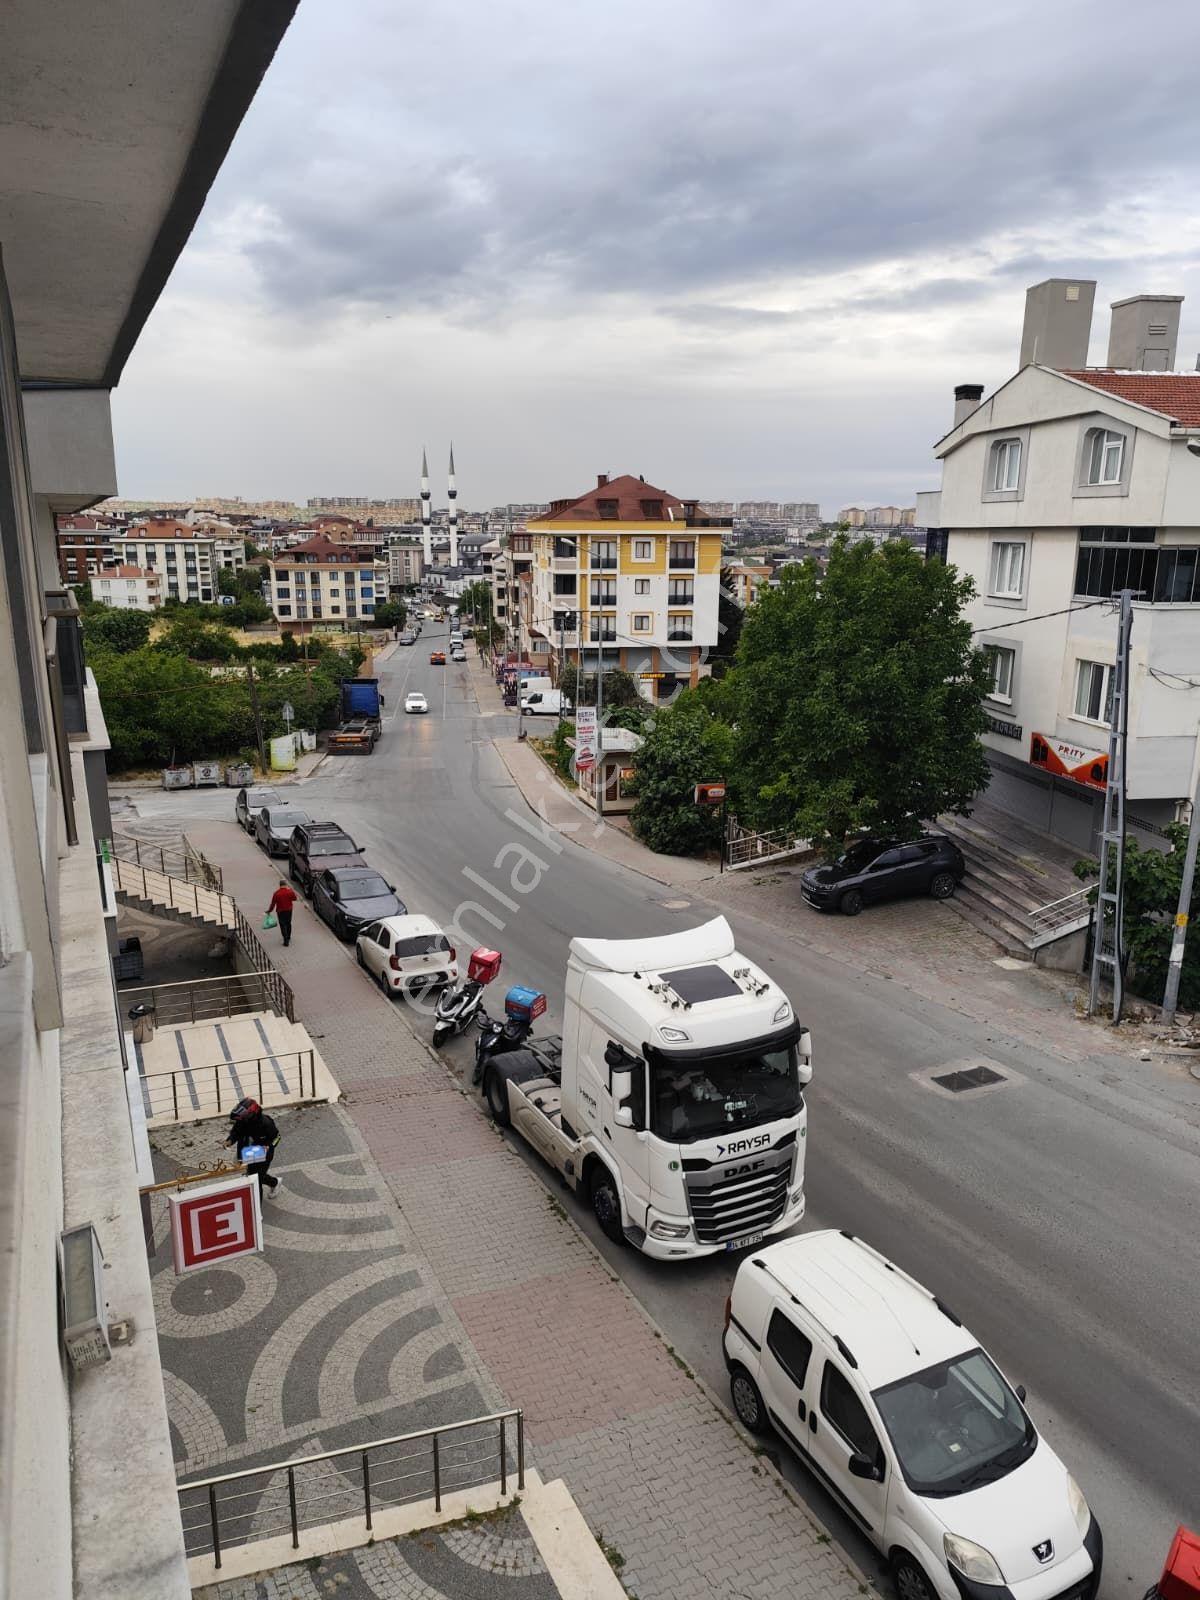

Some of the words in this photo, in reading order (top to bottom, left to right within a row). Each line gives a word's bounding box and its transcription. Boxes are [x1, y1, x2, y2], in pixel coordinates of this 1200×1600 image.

[1058, 744, 1085, 758] PRITY
[728, 1133, 770, 1154] RAYSA
[724, 1159, 765, 1178] DAF
[197, 1201, 239, 1251] E
